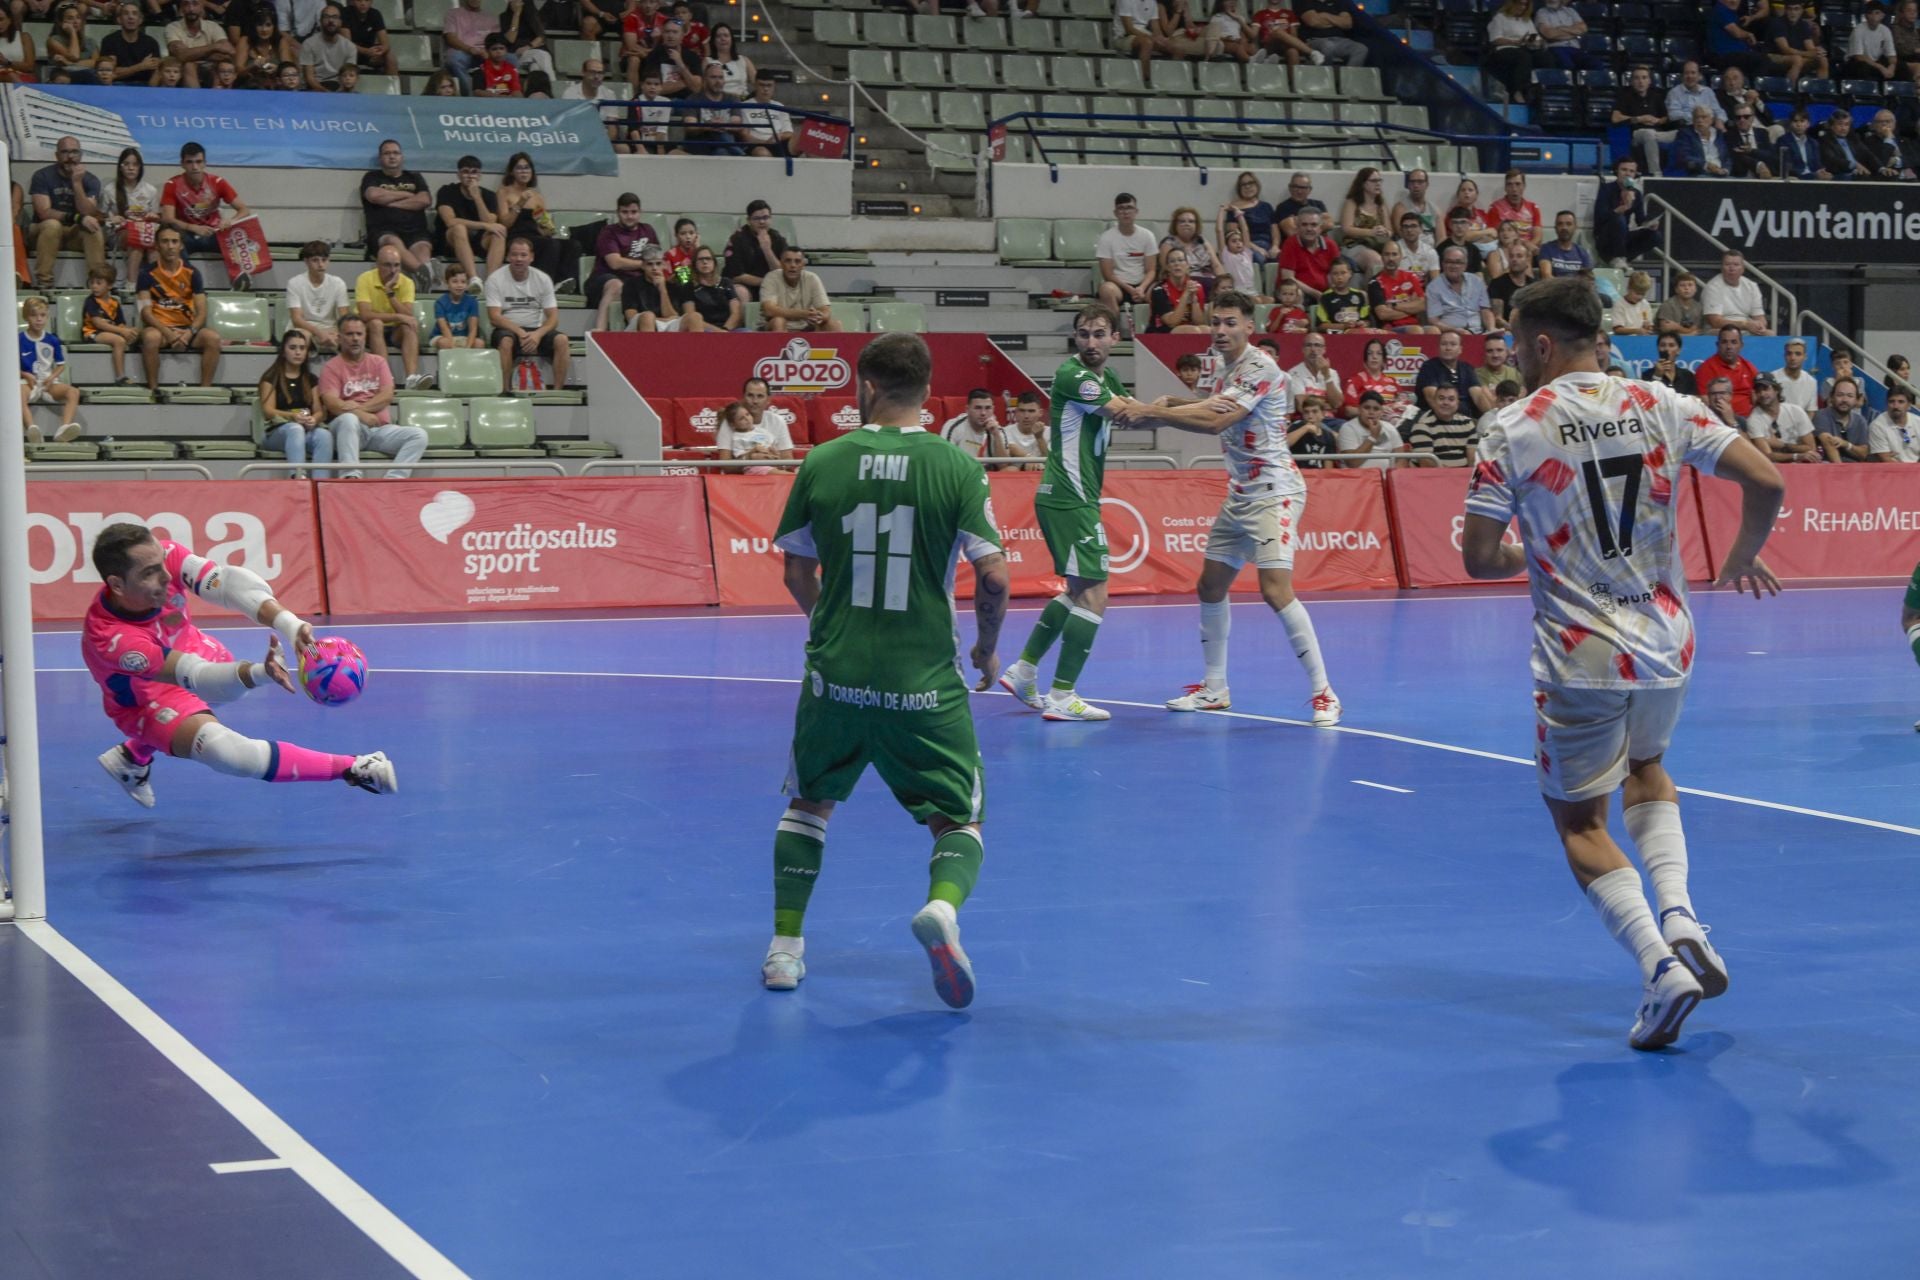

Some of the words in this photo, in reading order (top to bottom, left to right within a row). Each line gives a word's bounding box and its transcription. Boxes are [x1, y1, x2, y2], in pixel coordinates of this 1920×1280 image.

[136, 114, 167, 128] TU
[173, 116, 248, 130] HOTEL
[253, 117, 285, 130] EN
[291, 118, 380, 133] MURCIA
[438, 114, 551, 128] Occidental
[443, 129, 513, 143] Murcia
[517, 130, 580, 147] Agalia
[806, 128, 841, 145] MÓDULO
[818, 142, 825, 150] 1
[1385, 358, 1426, 371] POZO
[1558, 415, 1644, 446] Rivera
[858, 454, 910, 482] PANI
[1580, 452, 1645, 561] 17
[1161, 516, 1195, 527] Costa
[461, 521, 618, 551] cardiosalus
[1164, 533, 1209, 553] REG
[1295, 530, 1382, 551] MURCIA
[463, 549, 541, 581] sport
[841, 502, 915, 611] 11
[828, 683, 881, 709] TORREJÓN
[883, 691, 900, 711] DE
[900, 689, 940, 711] ARDOZ
